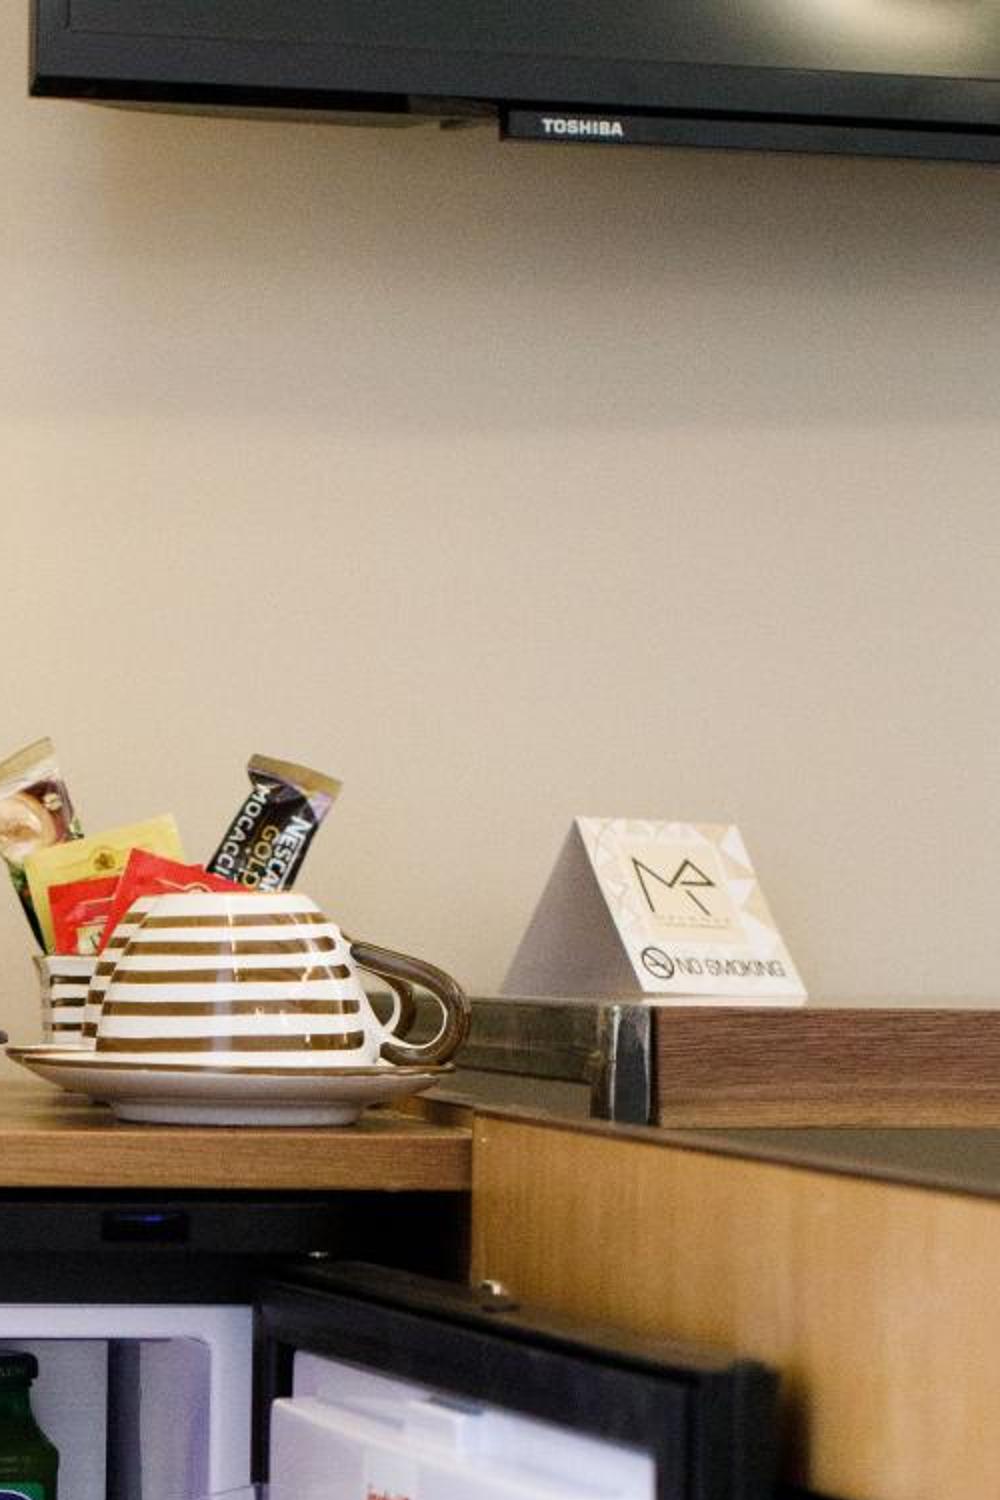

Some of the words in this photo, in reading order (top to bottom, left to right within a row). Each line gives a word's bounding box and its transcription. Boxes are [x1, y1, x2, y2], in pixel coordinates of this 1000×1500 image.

[541, 118, 624, 136] TOSHIBA
[675, 957, 704, 976] NO
[705, 958, 787, 977] SMOKING
